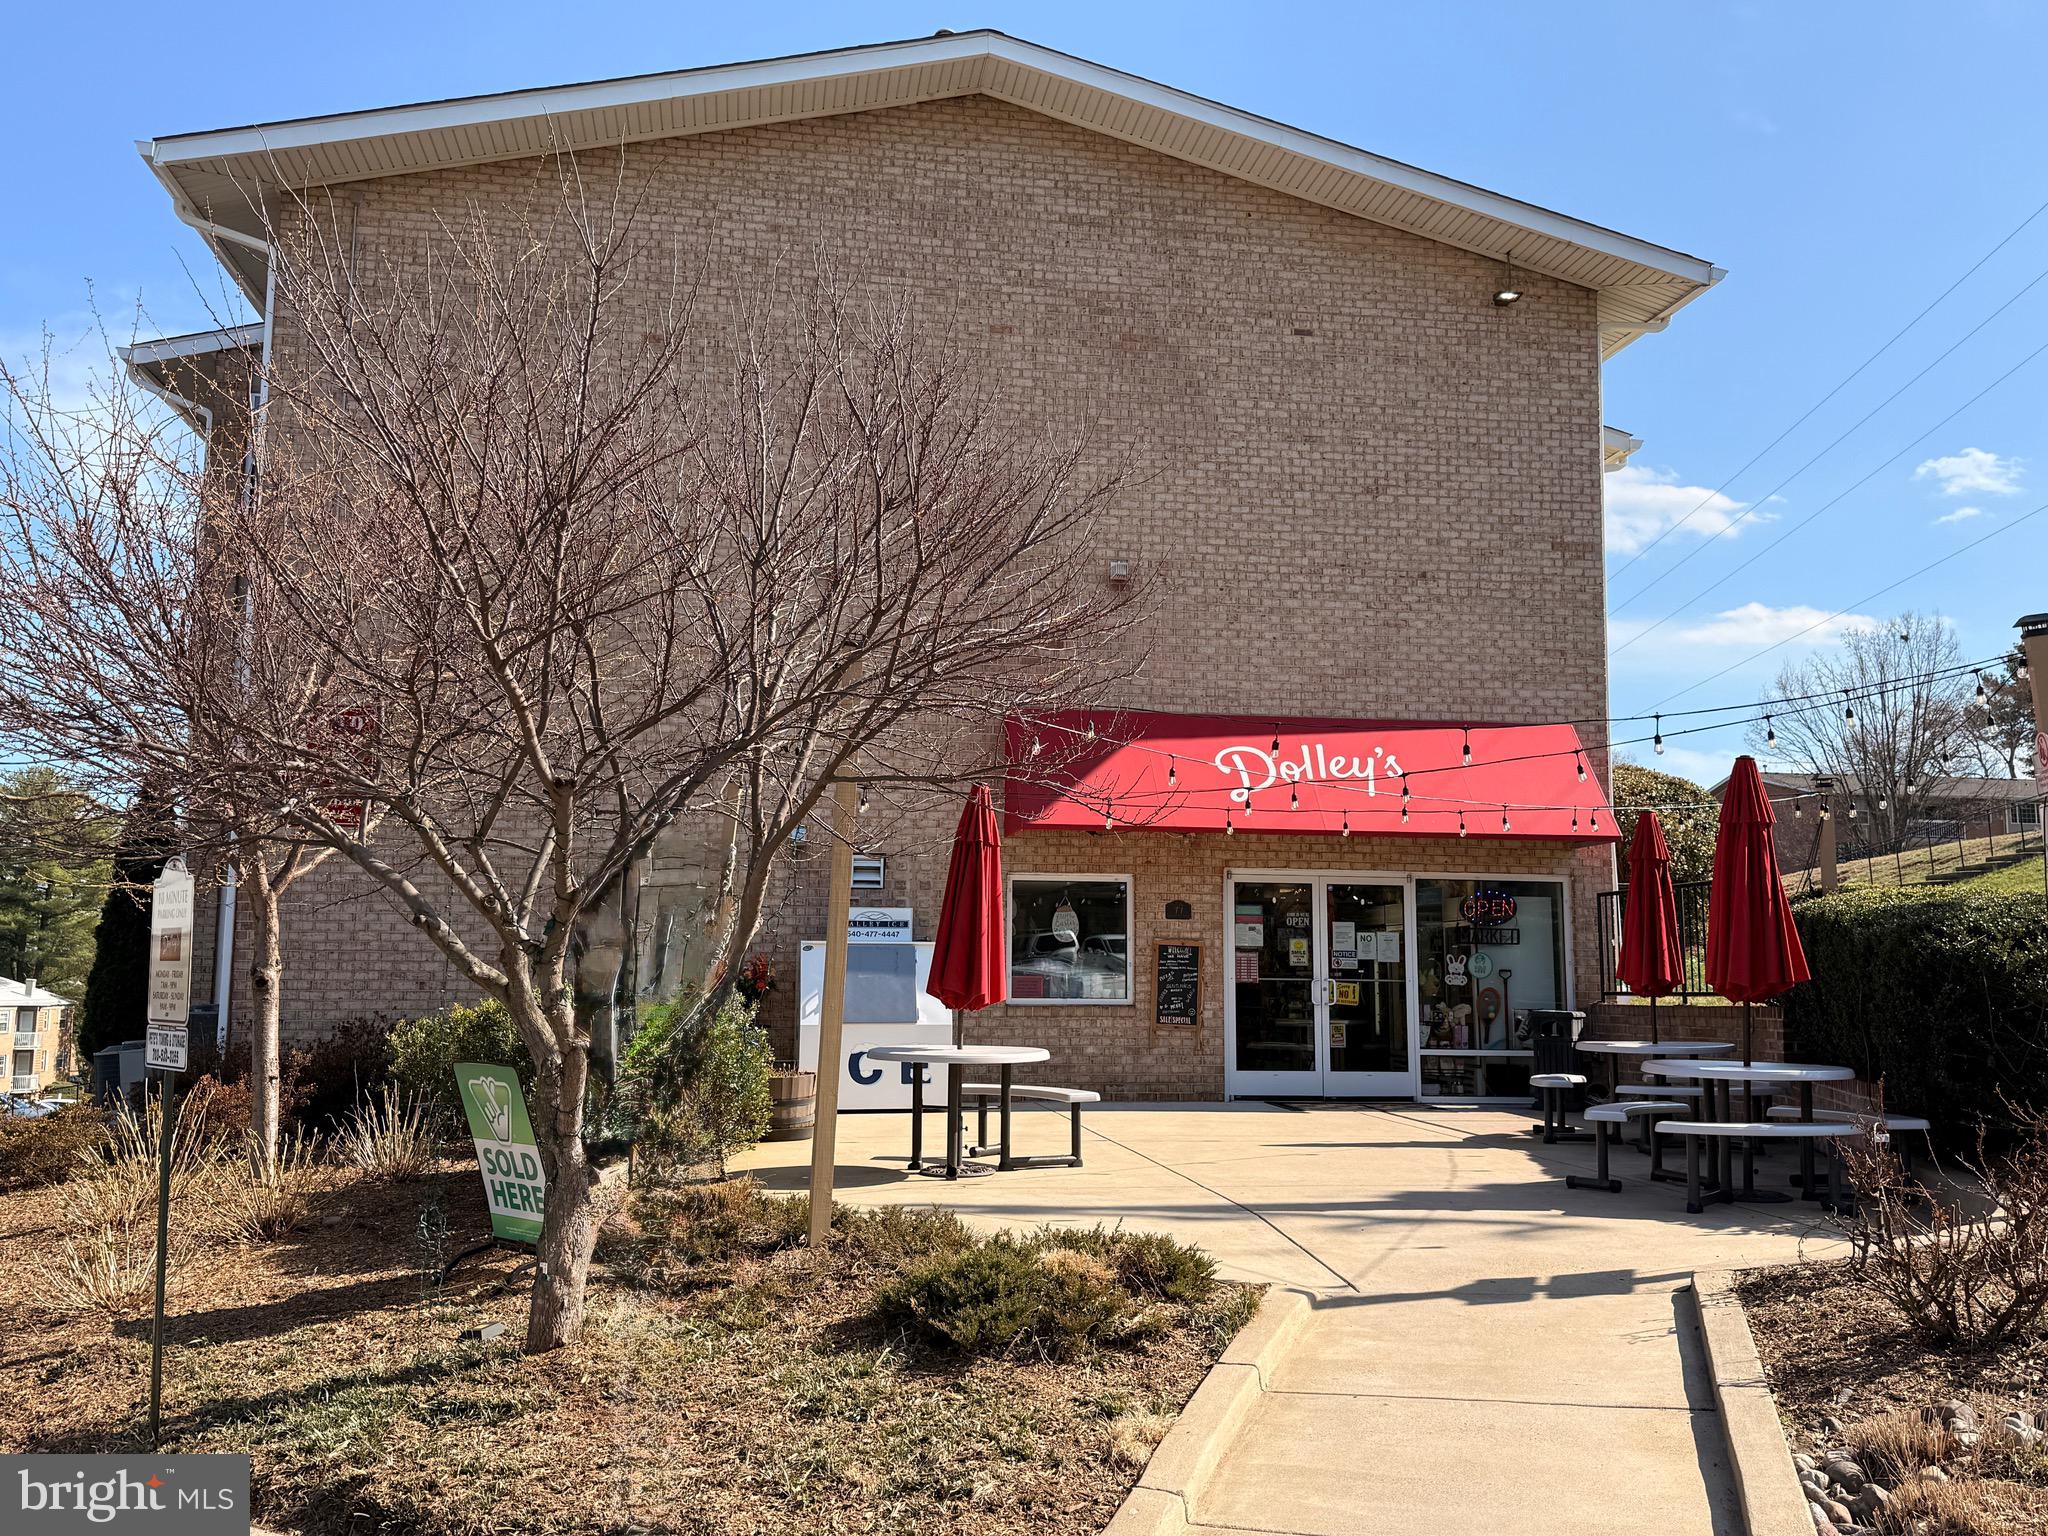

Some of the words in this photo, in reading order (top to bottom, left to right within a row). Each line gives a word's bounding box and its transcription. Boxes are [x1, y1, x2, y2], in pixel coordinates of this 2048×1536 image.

[1215, 743, 1404, 802] Dolley's
[1463, 898, 1514, 917] OPEN
[1286, 917, 1310, 926] OPEN
[1360, 934, 1372, 943] NO
[1339, 990, 1349, 999] NO
[483, 1147, 538, 1181] SOLD
[489, 1179, 545, 1215] HERE
